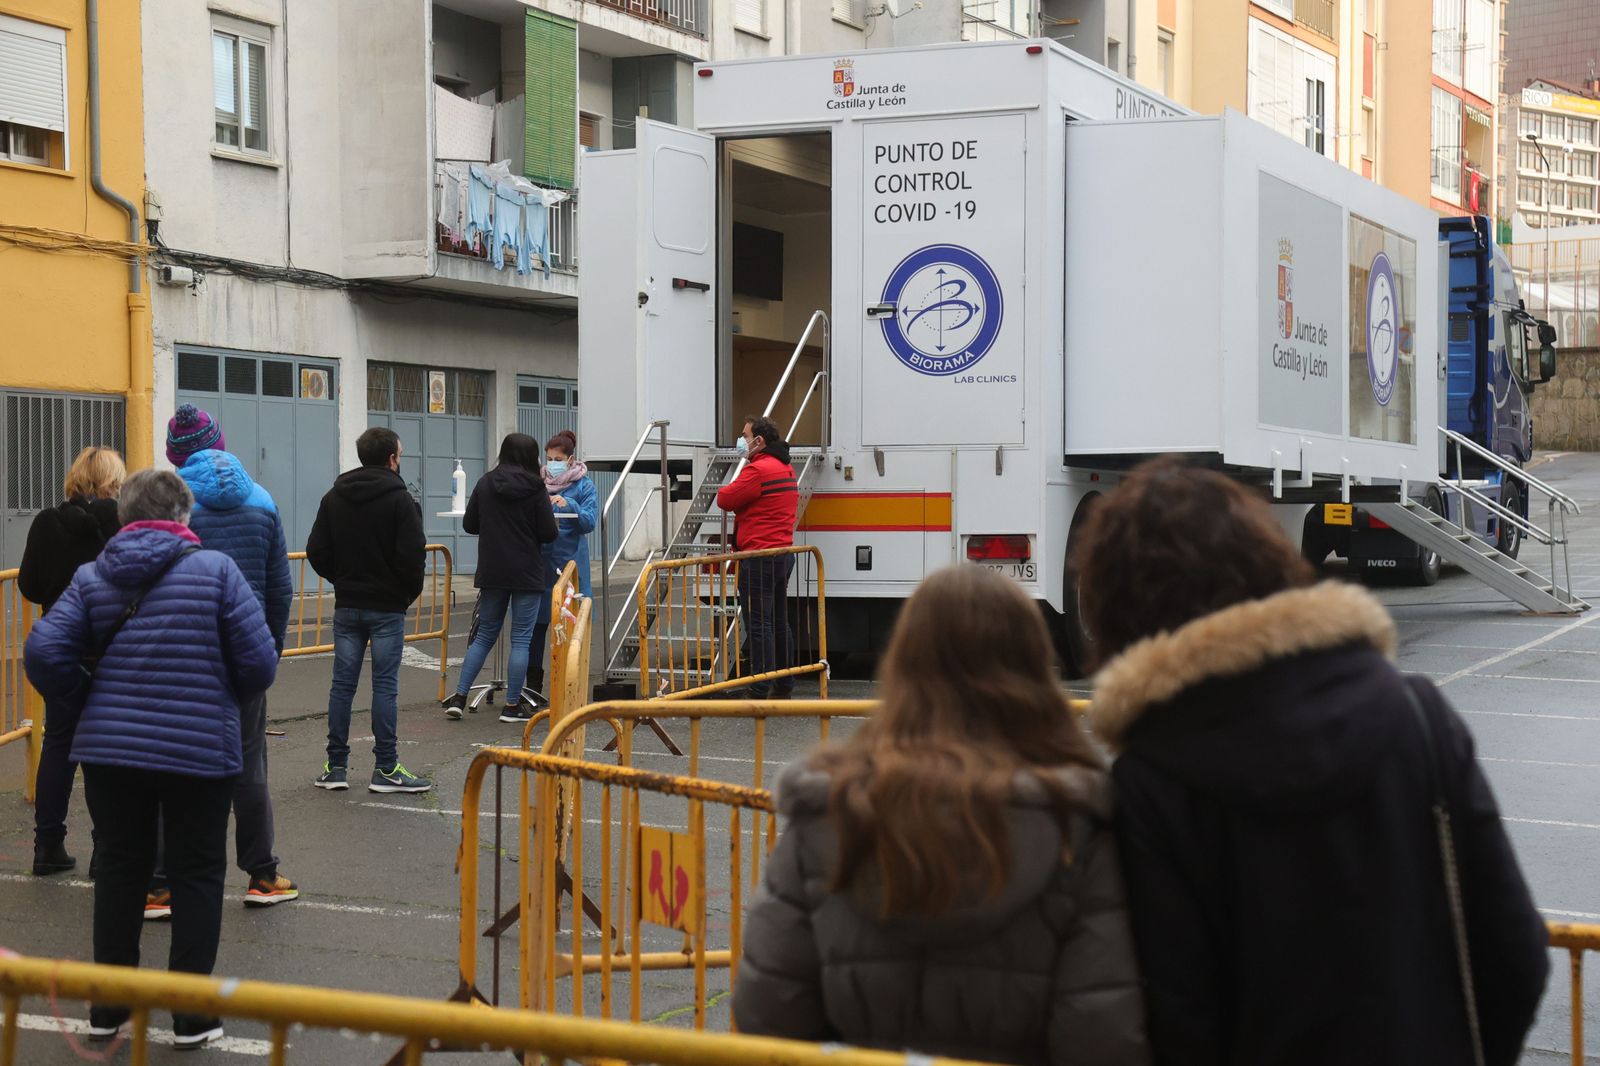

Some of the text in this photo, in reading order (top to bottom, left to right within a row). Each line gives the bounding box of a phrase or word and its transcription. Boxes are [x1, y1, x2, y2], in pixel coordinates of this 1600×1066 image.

[857, 83, 906, 95] Junta de
[826, 96, 906, 110] Castilla y León
[875, 140, 978, 164] PUNTO DE
[874, 171, 972, 194] CONTROL
[874, 200, 977, 223] COVID -19
[1294, 316, 1328, 347] Junta de
[909, 350, 975, 371] BIORAMA
[1272, 343, 1328, 381] Castilla y León
[976, 375, 1017, 383] CLINICS
[1009, 564, 1034, 578] JVS
[1367, 559, 1397, 567] IVECO
